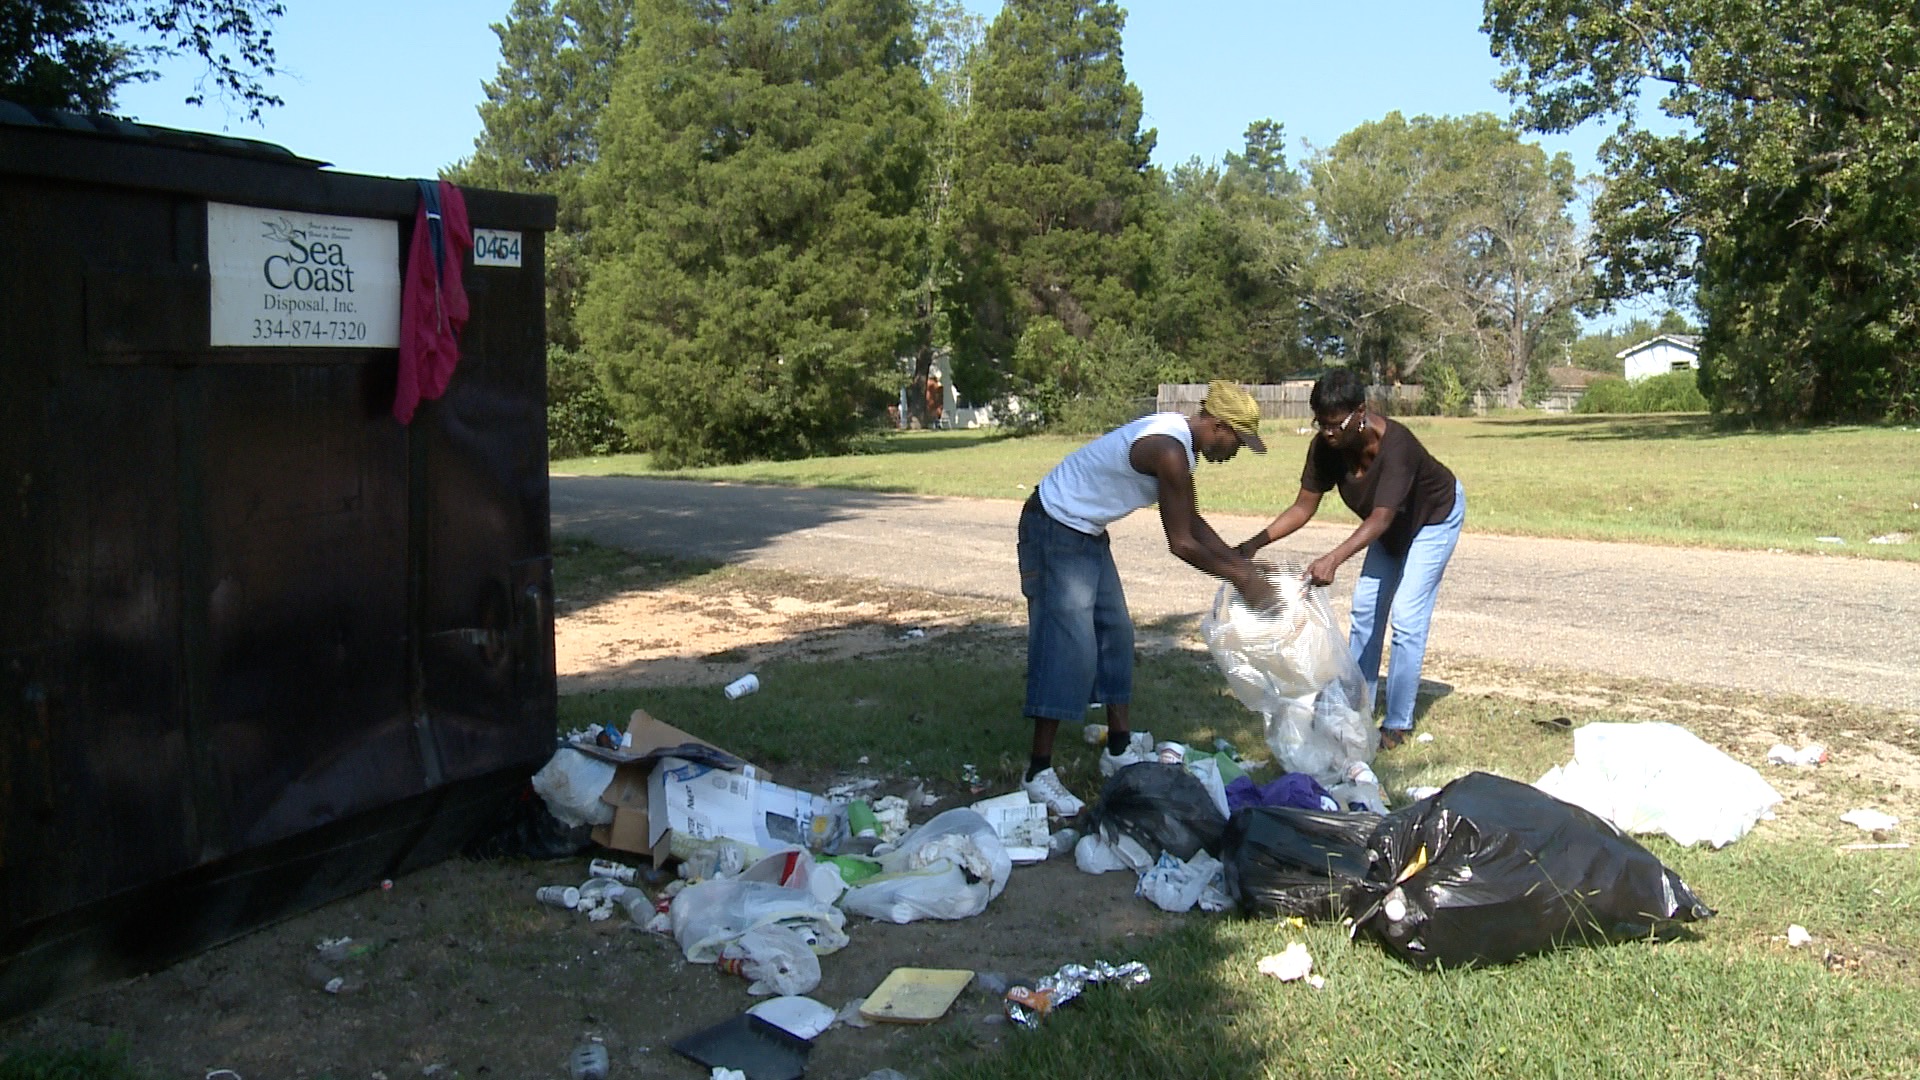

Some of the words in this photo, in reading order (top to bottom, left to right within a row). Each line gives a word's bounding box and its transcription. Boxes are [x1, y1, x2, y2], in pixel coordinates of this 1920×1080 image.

[289, 230, 345, 265] Sea
[475, 235, 520, 261] 0454
[263, 255, 355, 293] Coast
[263, 294, 329, 315] Disposal,
[333, 297, 357, 313] Inc.
[252, 319, 367, 340] 334-874-7320
